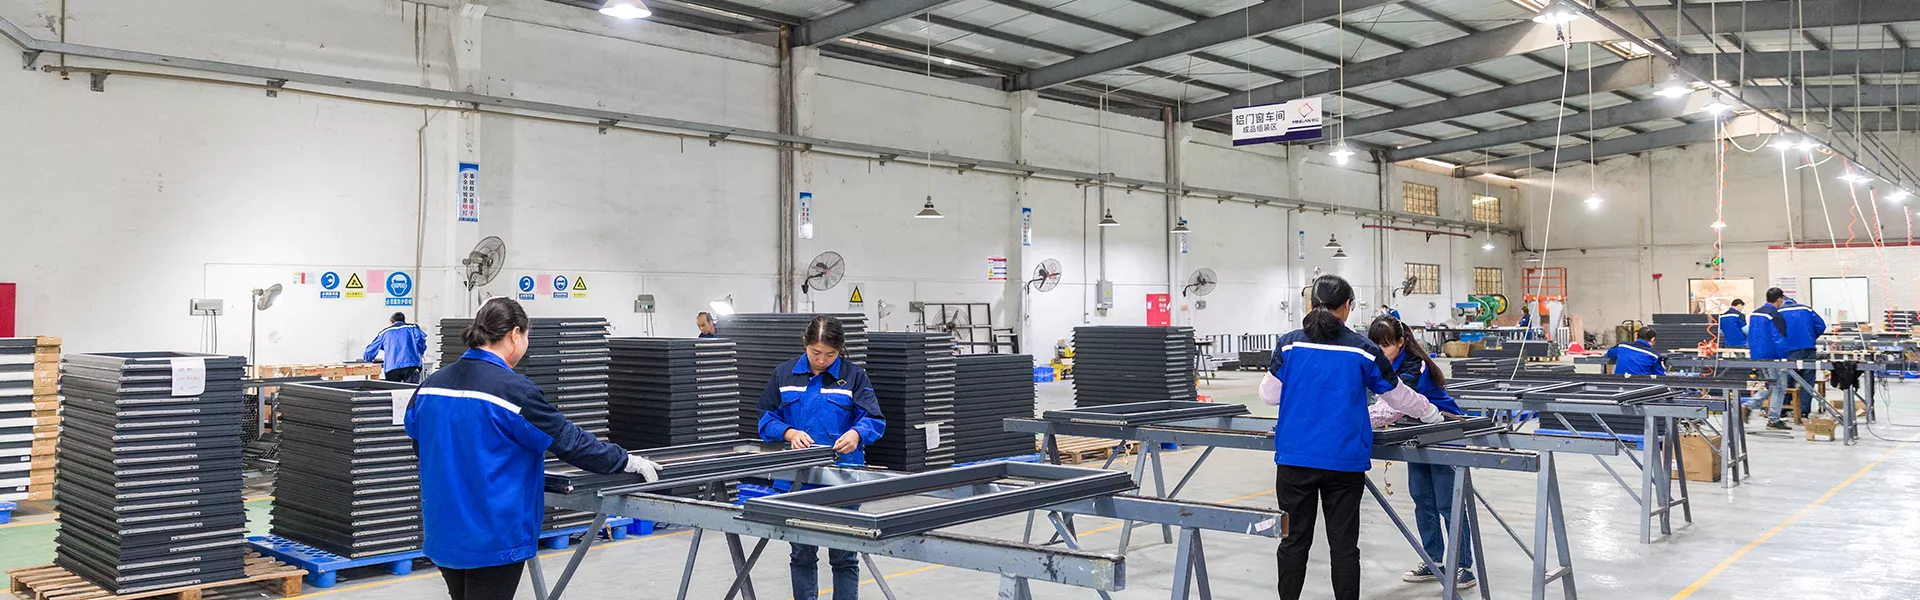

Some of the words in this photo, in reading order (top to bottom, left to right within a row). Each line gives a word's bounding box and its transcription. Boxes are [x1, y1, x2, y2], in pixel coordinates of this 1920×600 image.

[1235, 110, 1285, 125] 铝门窗车间
[1242, 123, 1277, 133] 成品组装区
